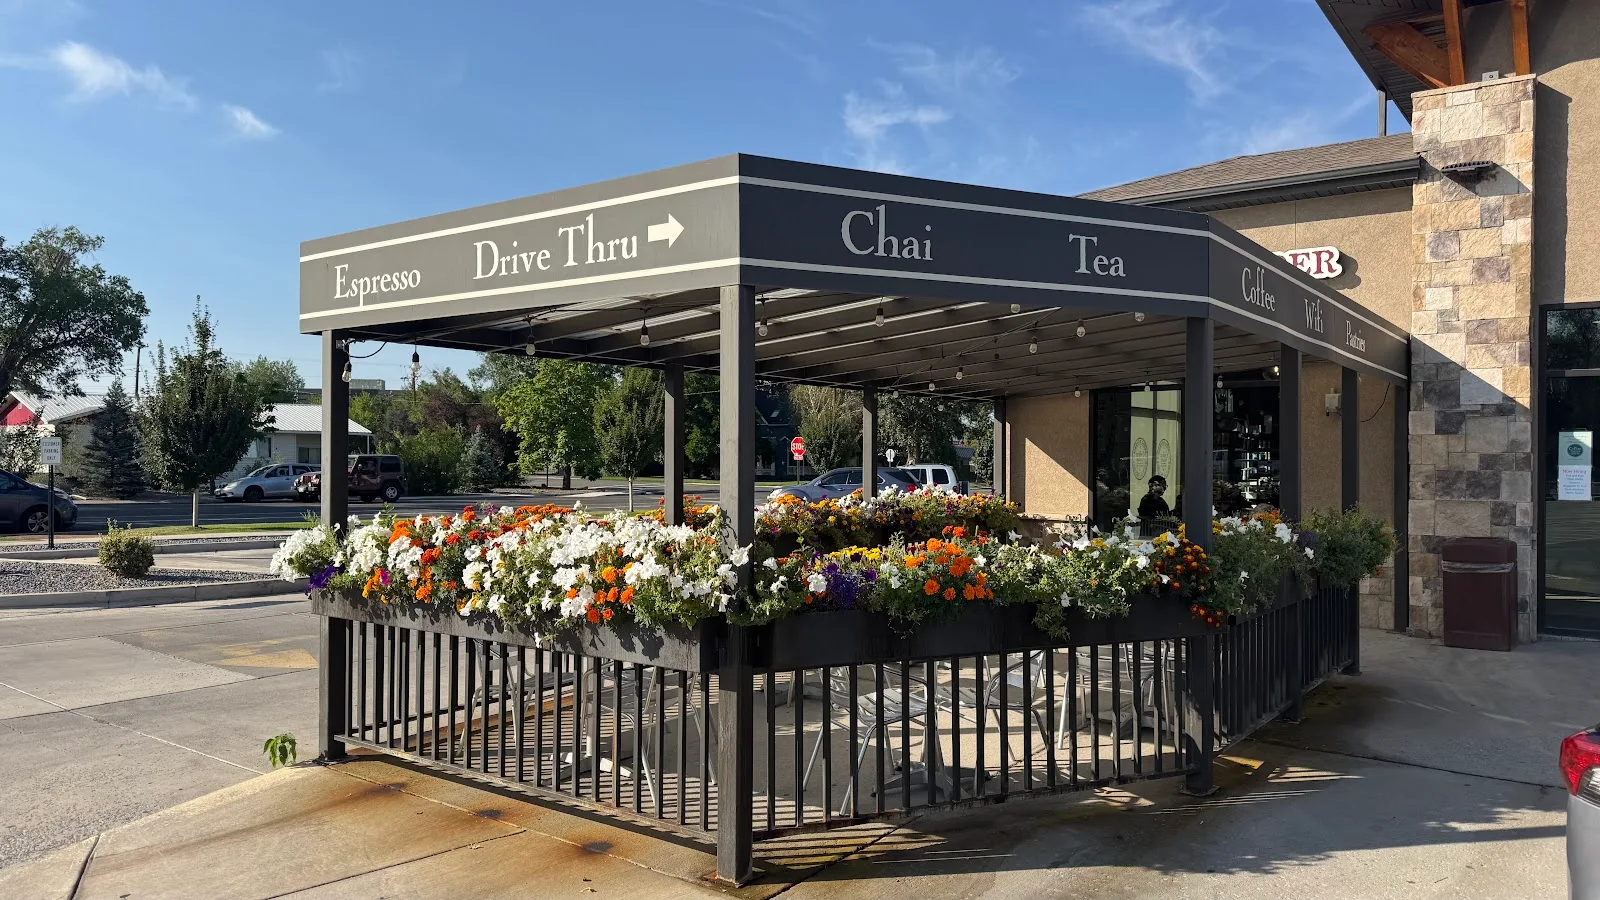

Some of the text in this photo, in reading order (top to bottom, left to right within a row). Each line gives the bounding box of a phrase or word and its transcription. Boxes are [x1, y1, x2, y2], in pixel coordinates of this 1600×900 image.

[334, 213, 638, 307] Espresso Drive Thru
[841, 204, 1126, 277] Chai Tea
[1242, 267, 1366, 352] Coffee Wifi Pastries
